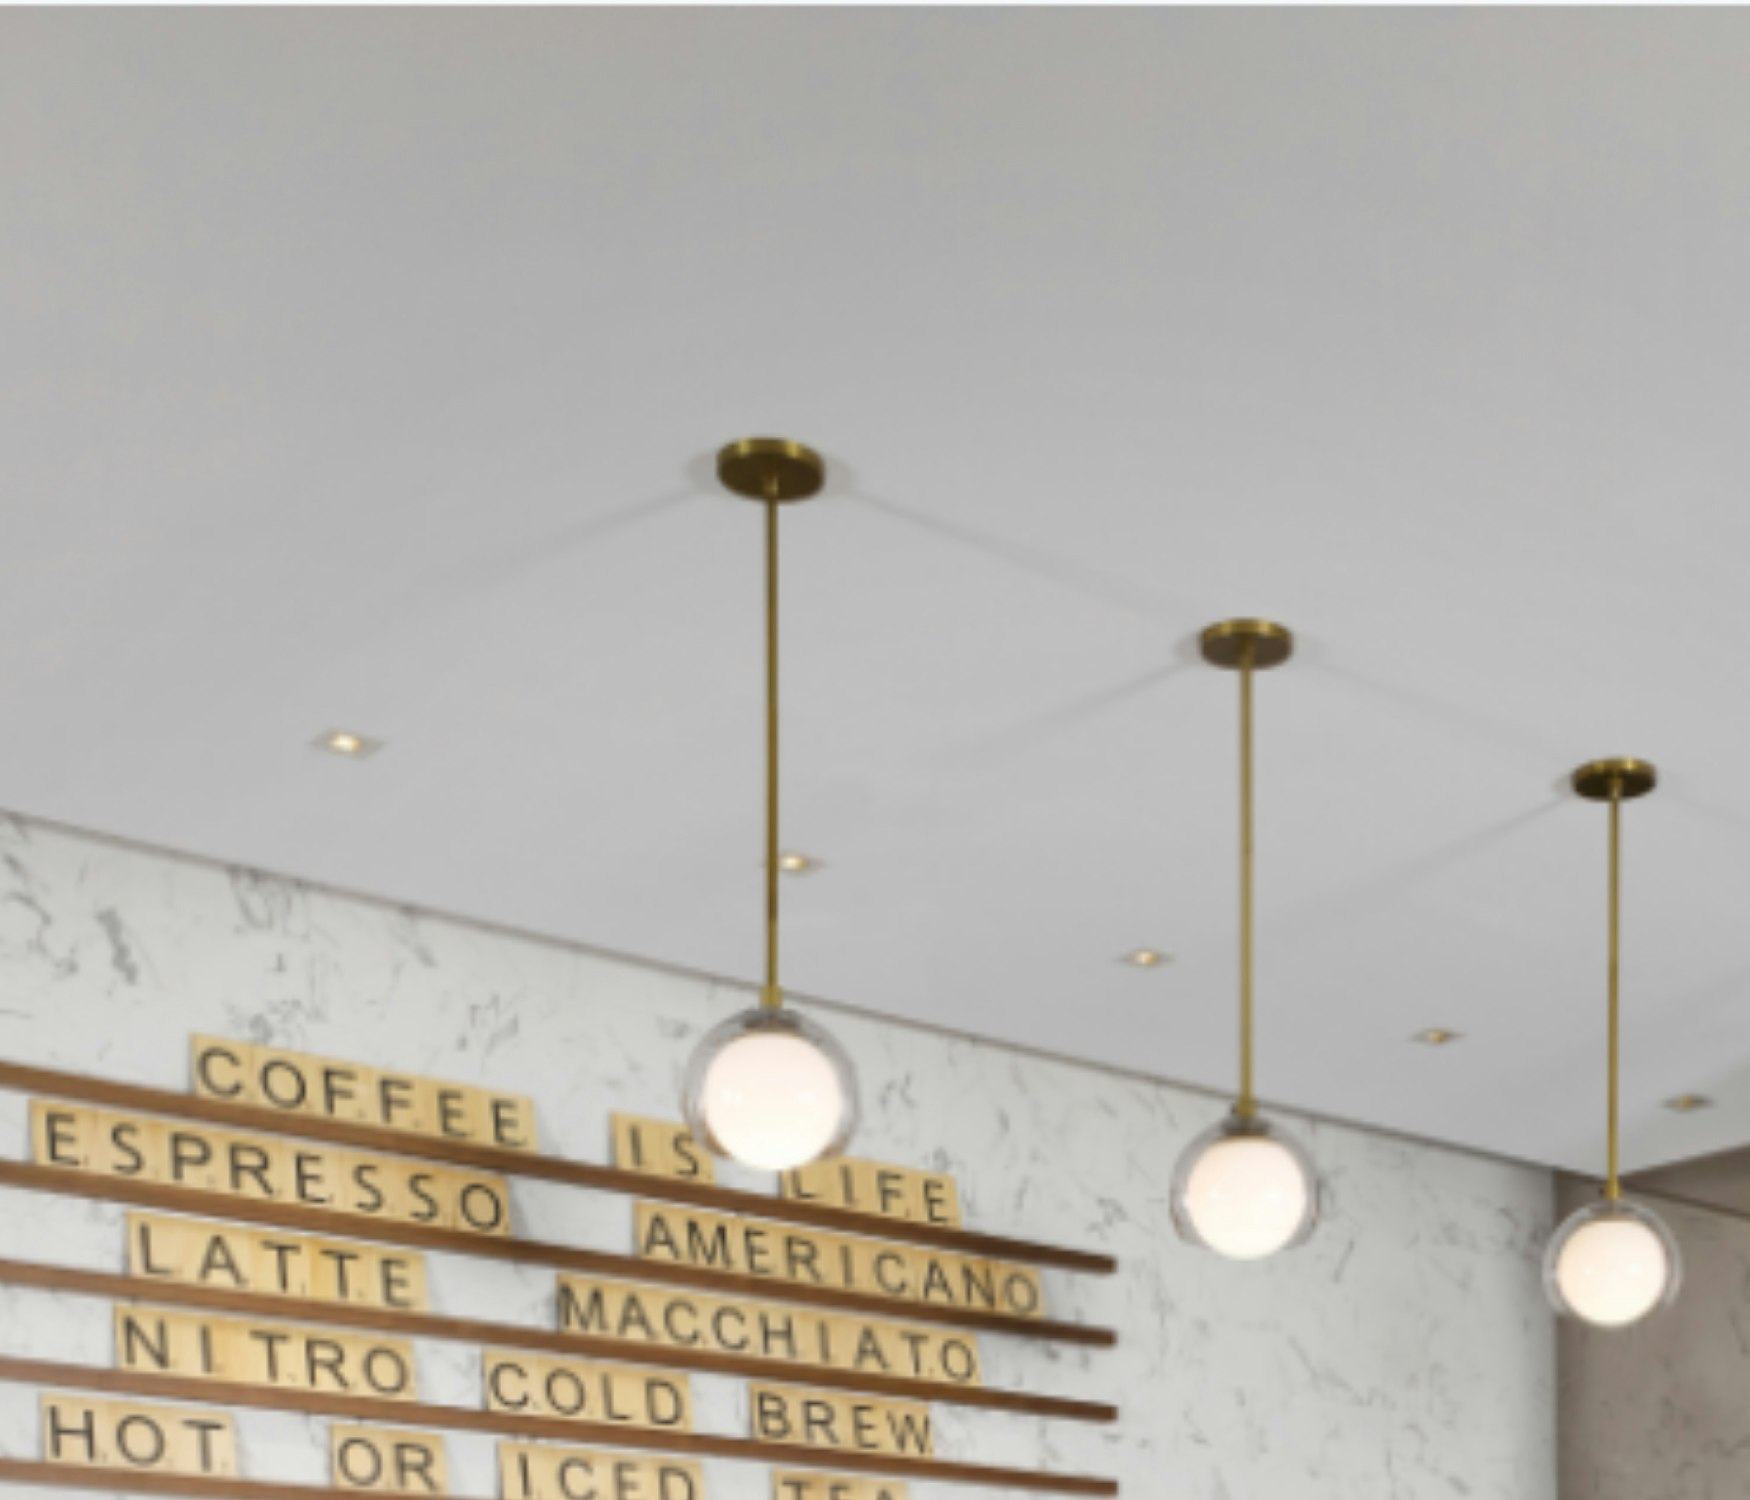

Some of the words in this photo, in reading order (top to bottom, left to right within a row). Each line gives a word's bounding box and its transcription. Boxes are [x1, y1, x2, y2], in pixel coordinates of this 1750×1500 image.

[45, 1112, 502, 1232] ESPRESSO
[644, 1213, 1039, 1312] AMERICANO
[199, 1046, 525, 1146] COFFEE
[631, 1124, 699, 1177] IS
[791, 1164, 948, 1223] LIFE
[139, 1223, 412, 1308] LATTE
[562, 1284, 975, 1380] MACCHIATO
[47, 1405, 227, 1472] HOT
[338, 1436, 439, 1491] OR
[122, 1315, 407, 1394] NITRO
[490, 1362, 684, 1426] COLD
[758, 1391, 930, 1454] BREW
